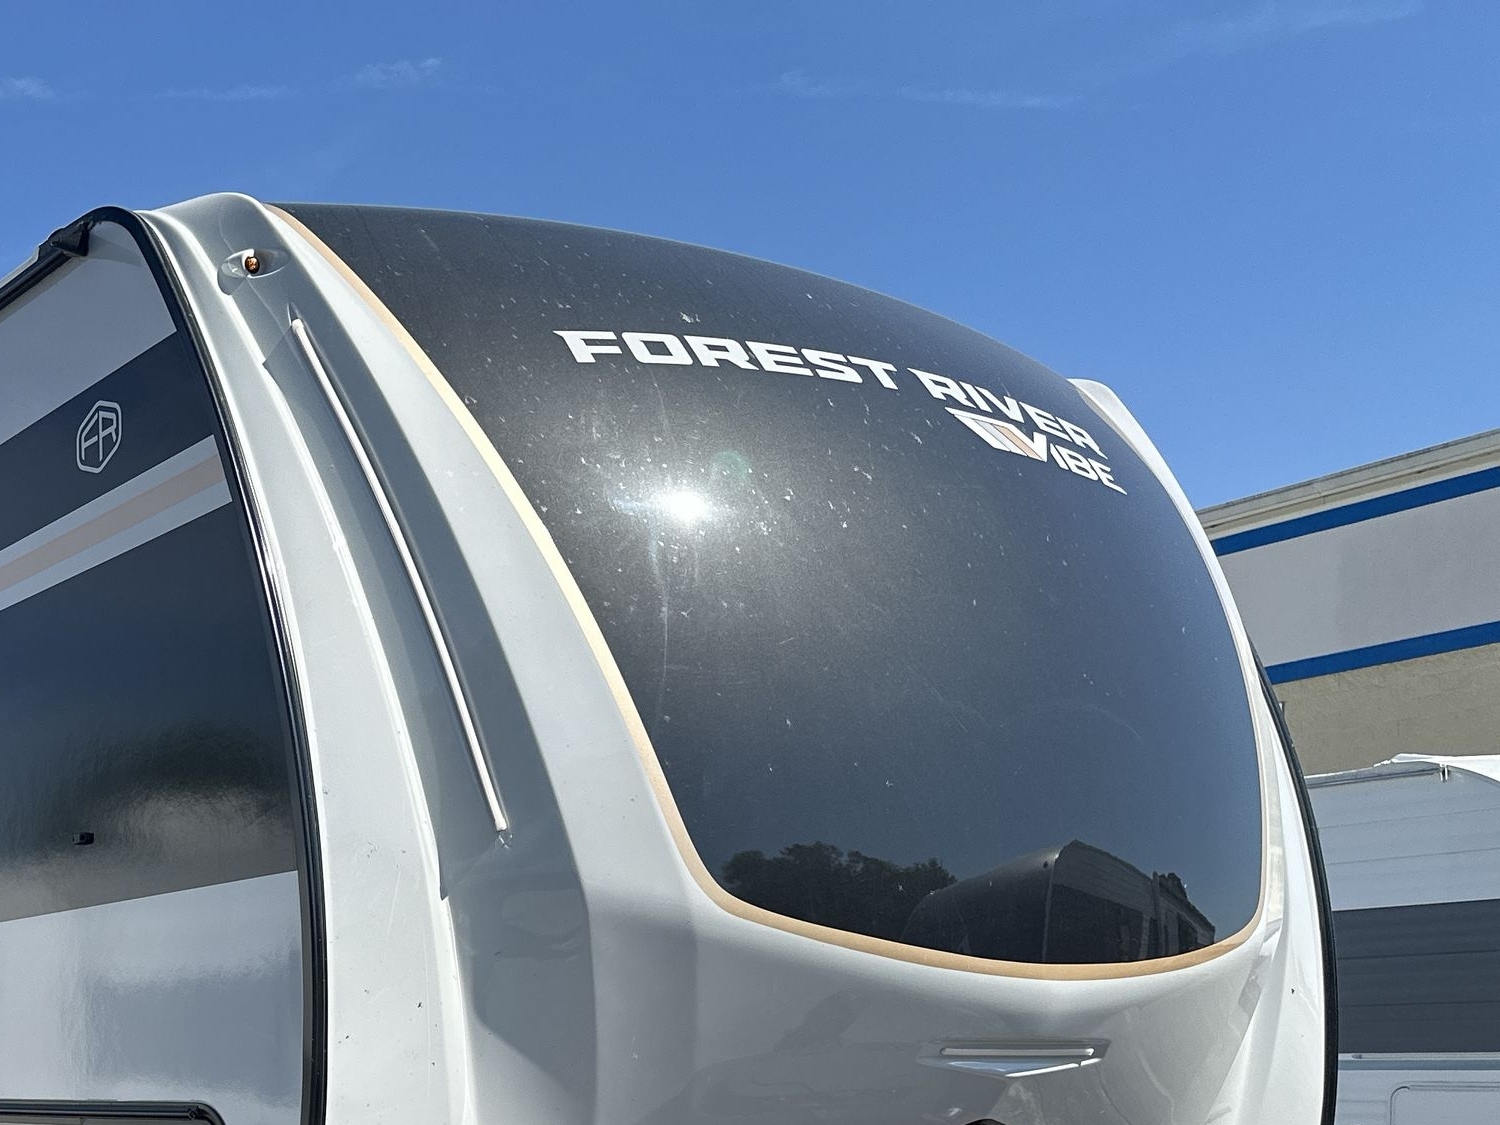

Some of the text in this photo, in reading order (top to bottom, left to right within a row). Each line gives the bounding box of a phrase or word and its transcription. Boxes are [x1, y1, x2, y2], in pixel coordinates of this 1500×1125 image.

[553, 330, 1108, 459] FOREST RIVER
[945, 407, 1127, 495] VIBE
